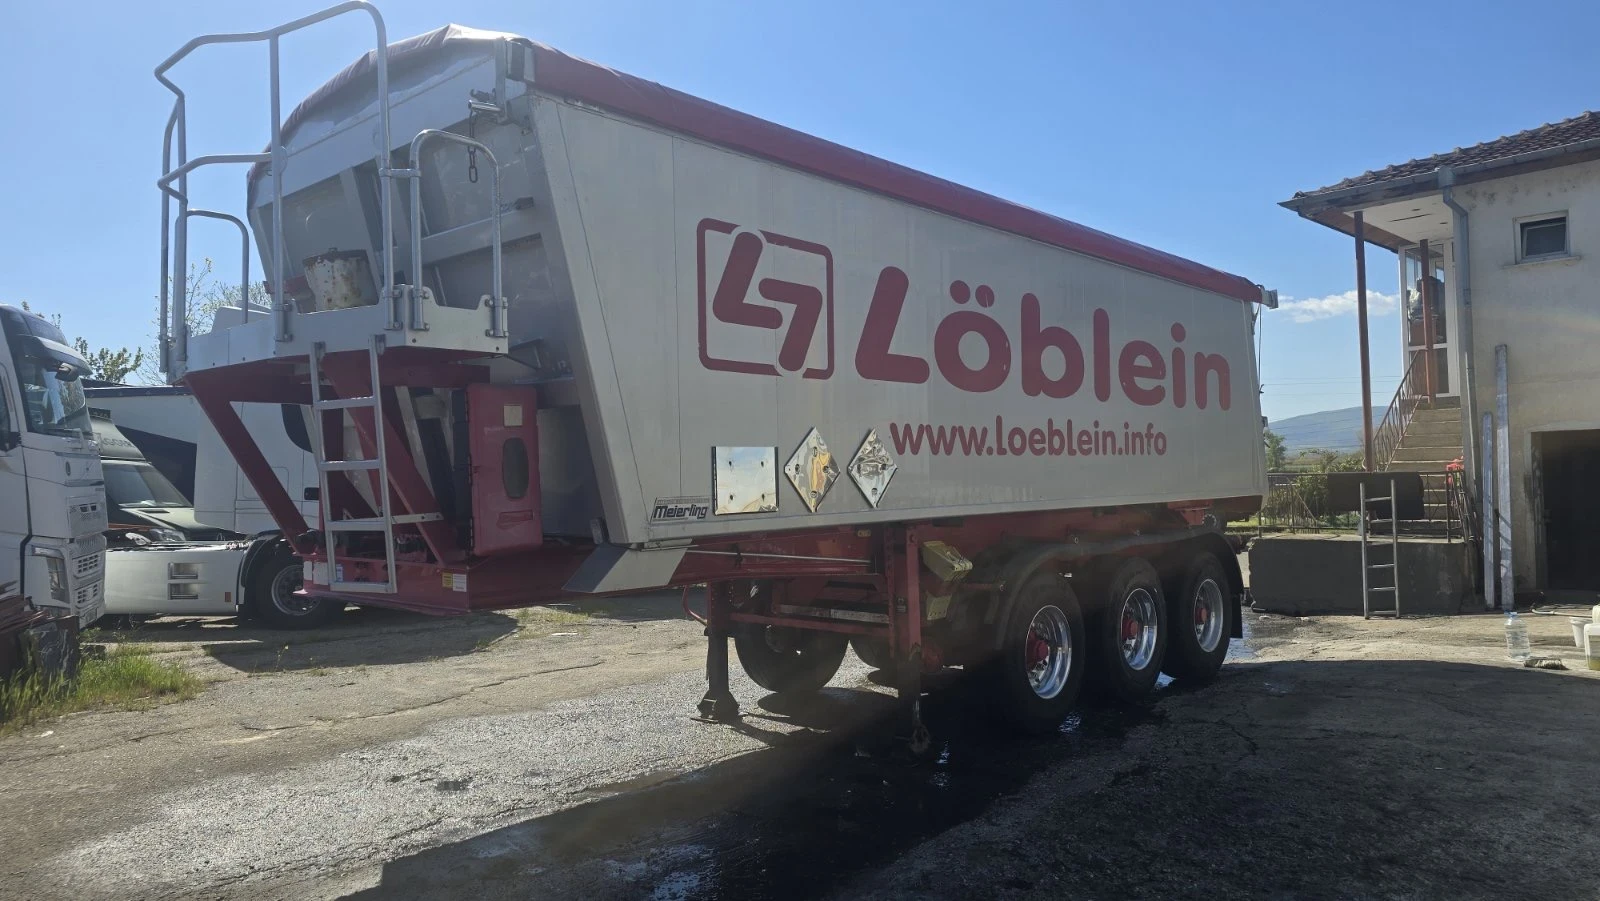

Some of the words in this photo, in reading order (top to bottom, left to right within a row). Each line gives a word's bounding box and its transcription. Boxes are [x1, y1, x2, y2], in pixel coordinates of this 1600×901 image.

[855, 266, 1231, 411] Löblein
[890, 415, 1167, 456] www.loeblein.info
[653, 504, 708, 519] Meierling
